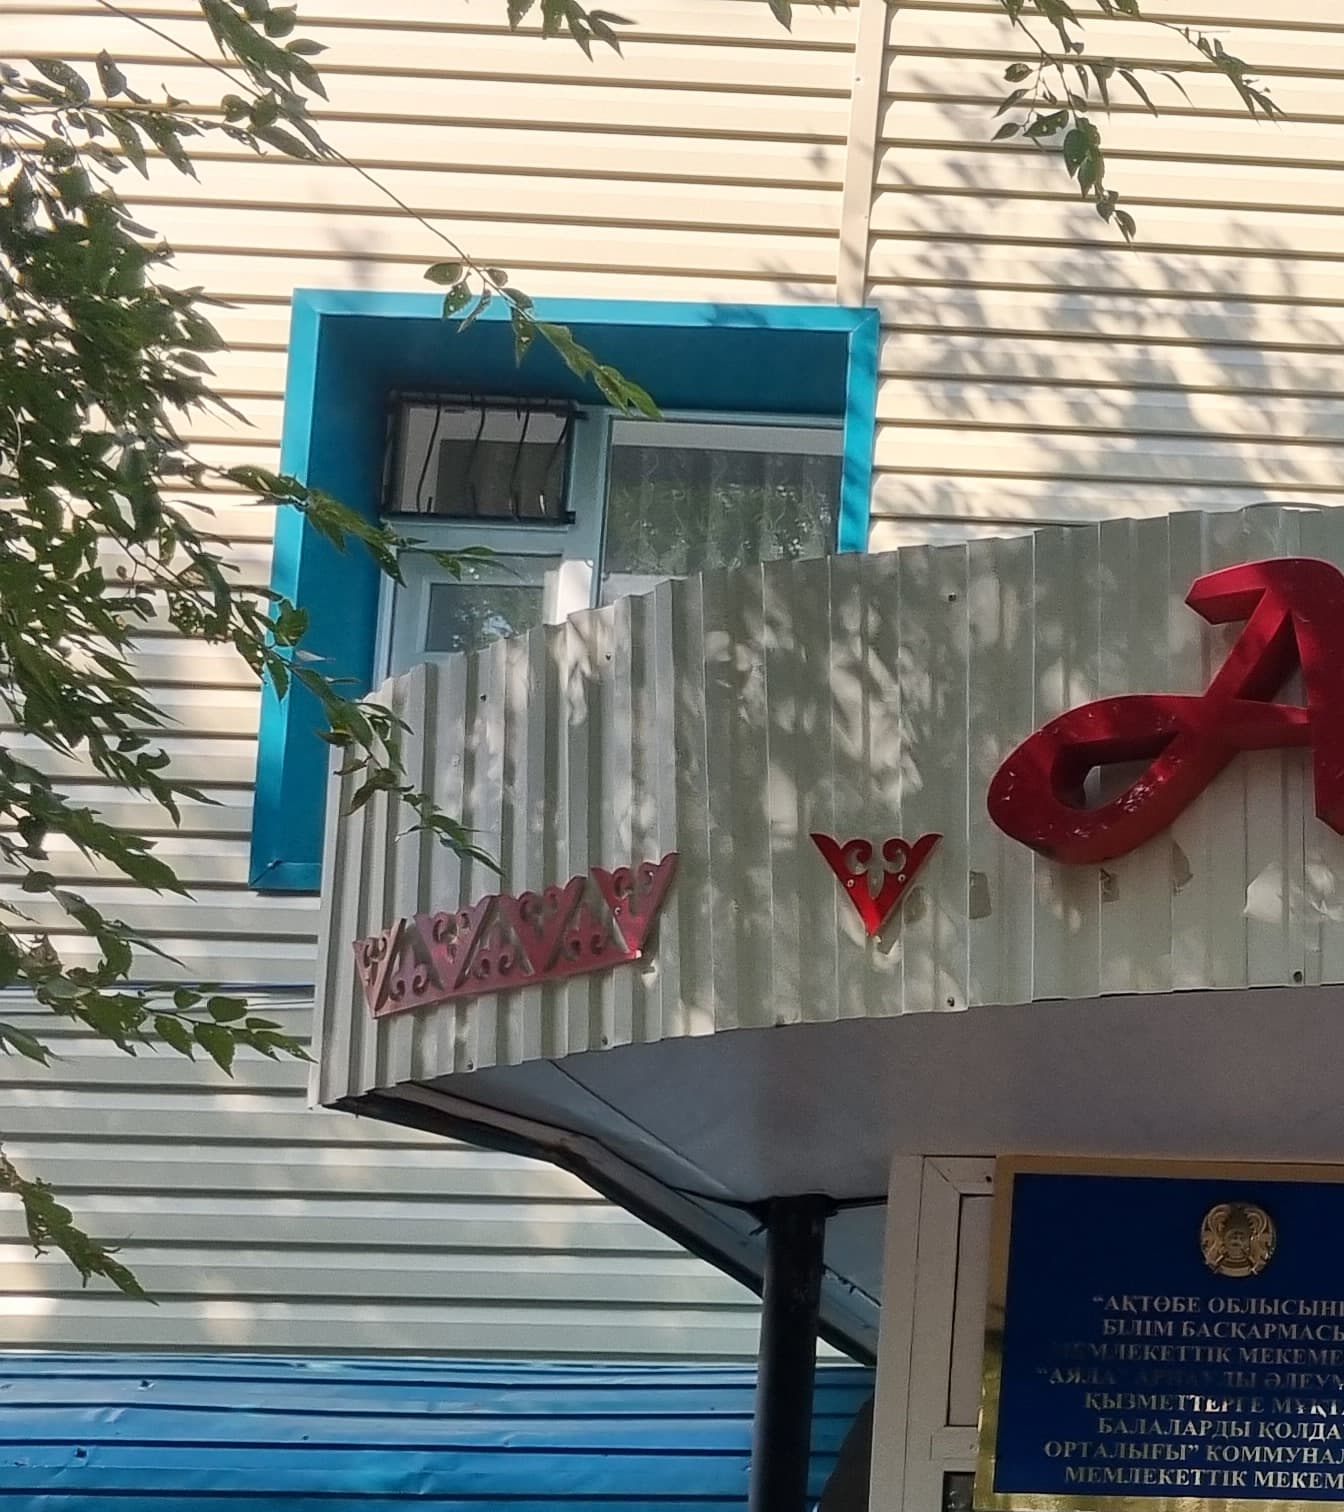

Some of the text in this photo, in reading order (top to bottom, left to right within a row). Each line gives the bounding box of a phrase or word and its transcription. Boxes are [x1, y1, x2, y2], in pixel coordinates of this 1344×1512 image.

[1103, 1319, 1174, 1337] БІЛІМ
[1099, 1417, 1250, 1438] БАЛАЛАРДЫ
[1065, 1465, 1247, 1487] МЕМЛЕКЕТТІК
